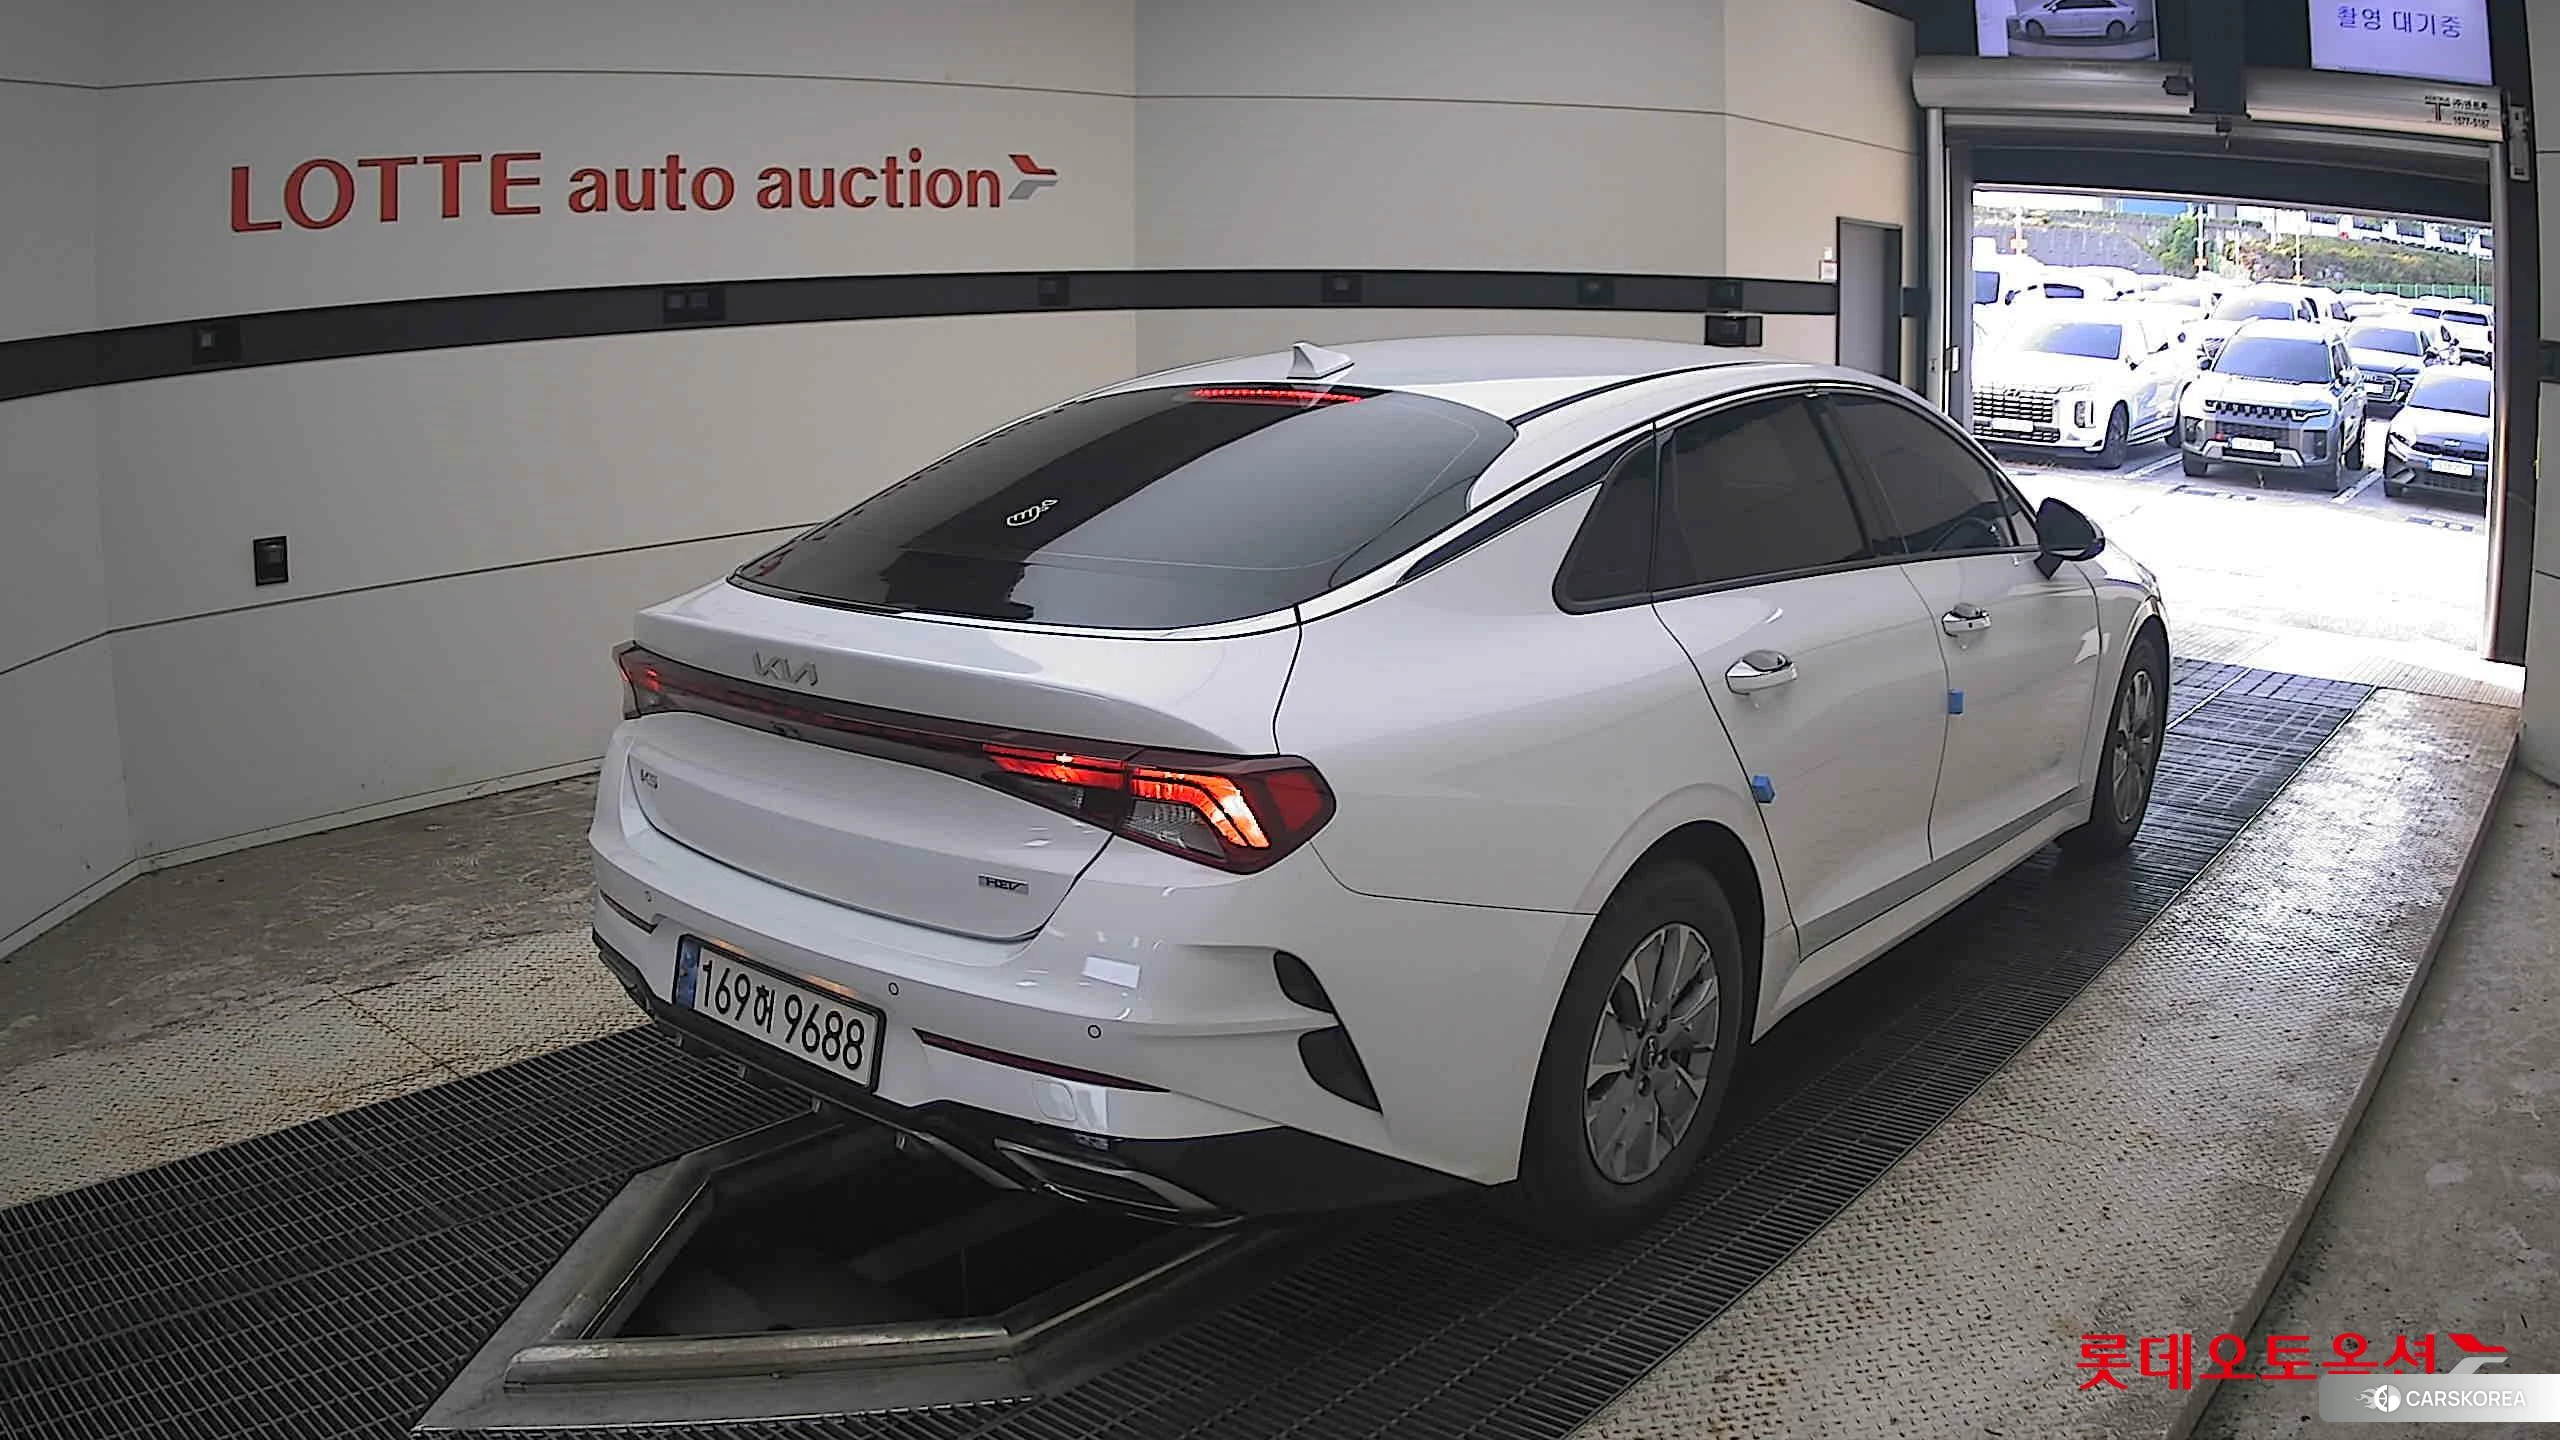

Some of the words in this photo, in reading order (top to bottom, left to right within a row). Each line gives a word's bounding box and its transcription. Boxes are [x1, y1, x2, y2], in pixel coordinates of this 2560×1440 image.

[2338, 6, 2381, 30] 촬영
[2393, 11, 2462, 38] 대기중
[231, 152, 542, 233] LOTTE
[568, 153, 735, 213] auto
[757, 147, 1001, 210] auction
[752, 648, 818, 687] KIA
[702, 959, 776, 1034] 169허
[784, 993, 865, 1071] 9688
